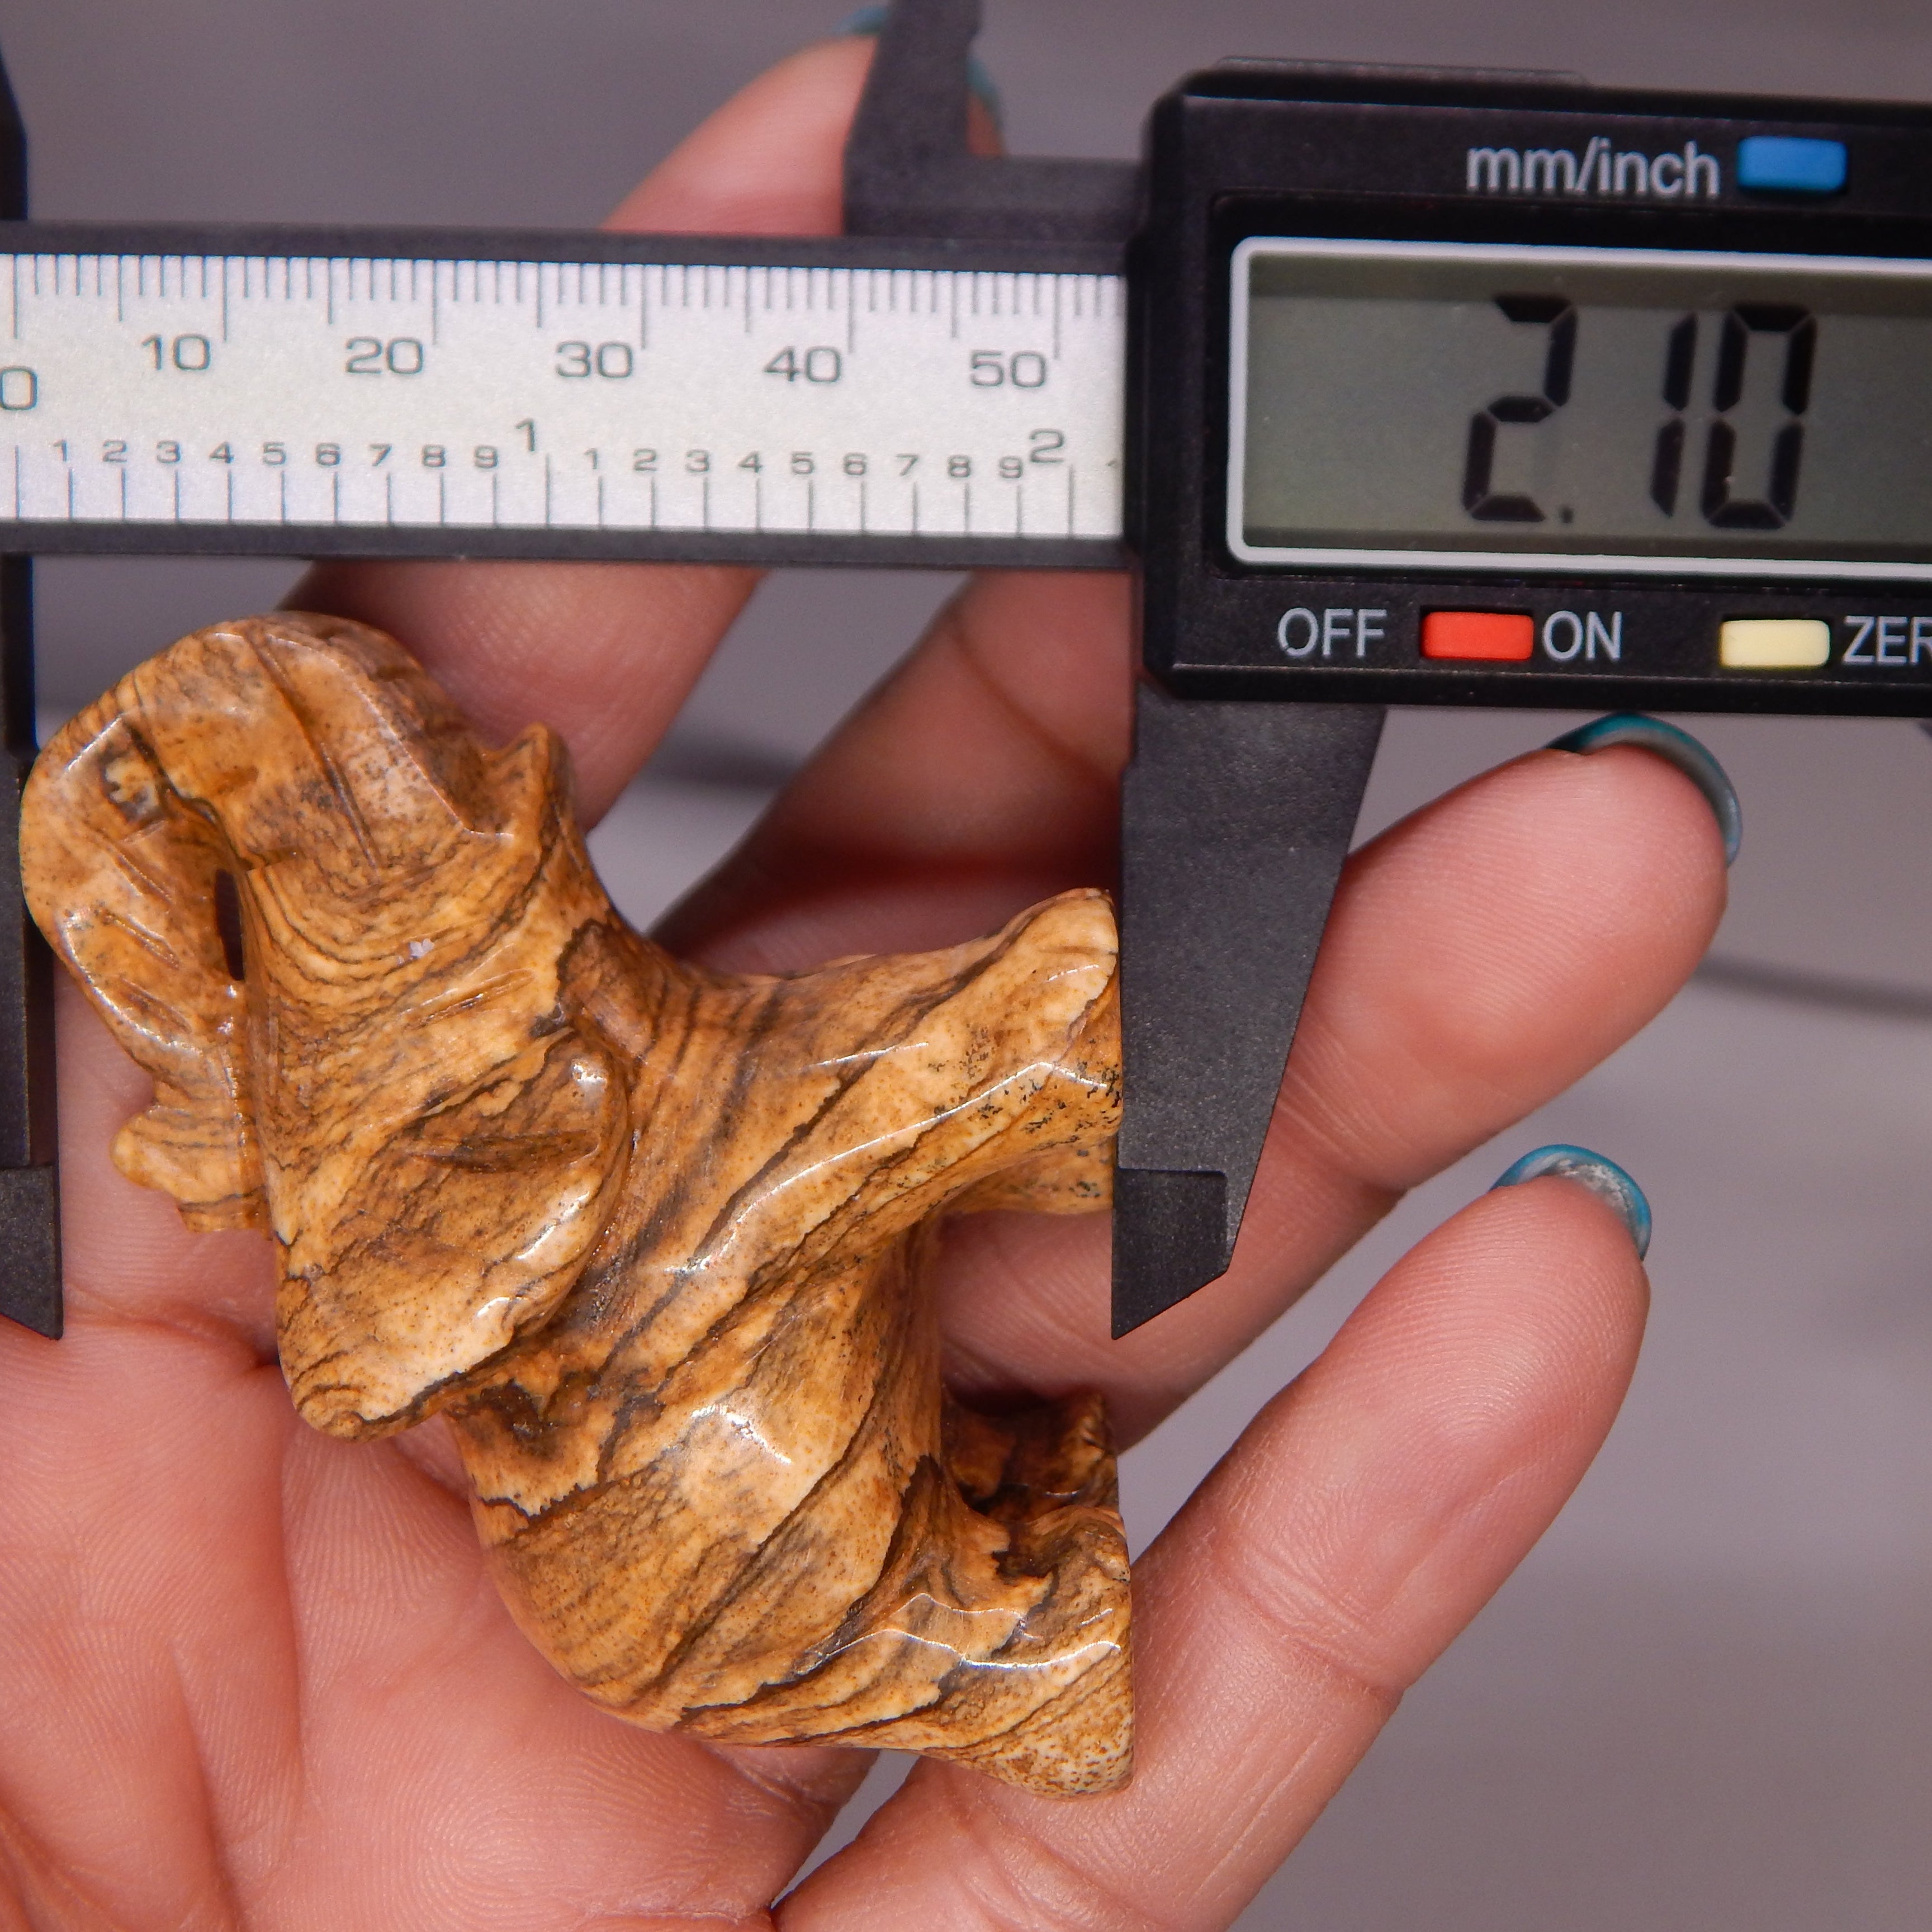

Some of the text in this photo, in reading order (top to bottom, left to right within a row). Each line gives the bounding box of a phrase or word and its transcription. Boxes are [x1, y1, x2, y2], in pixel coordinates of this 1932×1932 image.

[1466, 136, 1720, 198] mm/inch
[0, 366, 38, 411] 0
[141, 334, 1047, 389] 10 20 30 40 50
[1461, 293, 1817, 530] 2.10
[53, 418, 1066, 480] 1 2 3 4 5 6 7 8 9 1 1 2 3 4 5 6 7 8 9 2
[1277, 607, 1388, 658] OFF
[1542, 610, 1622, 661] ON
